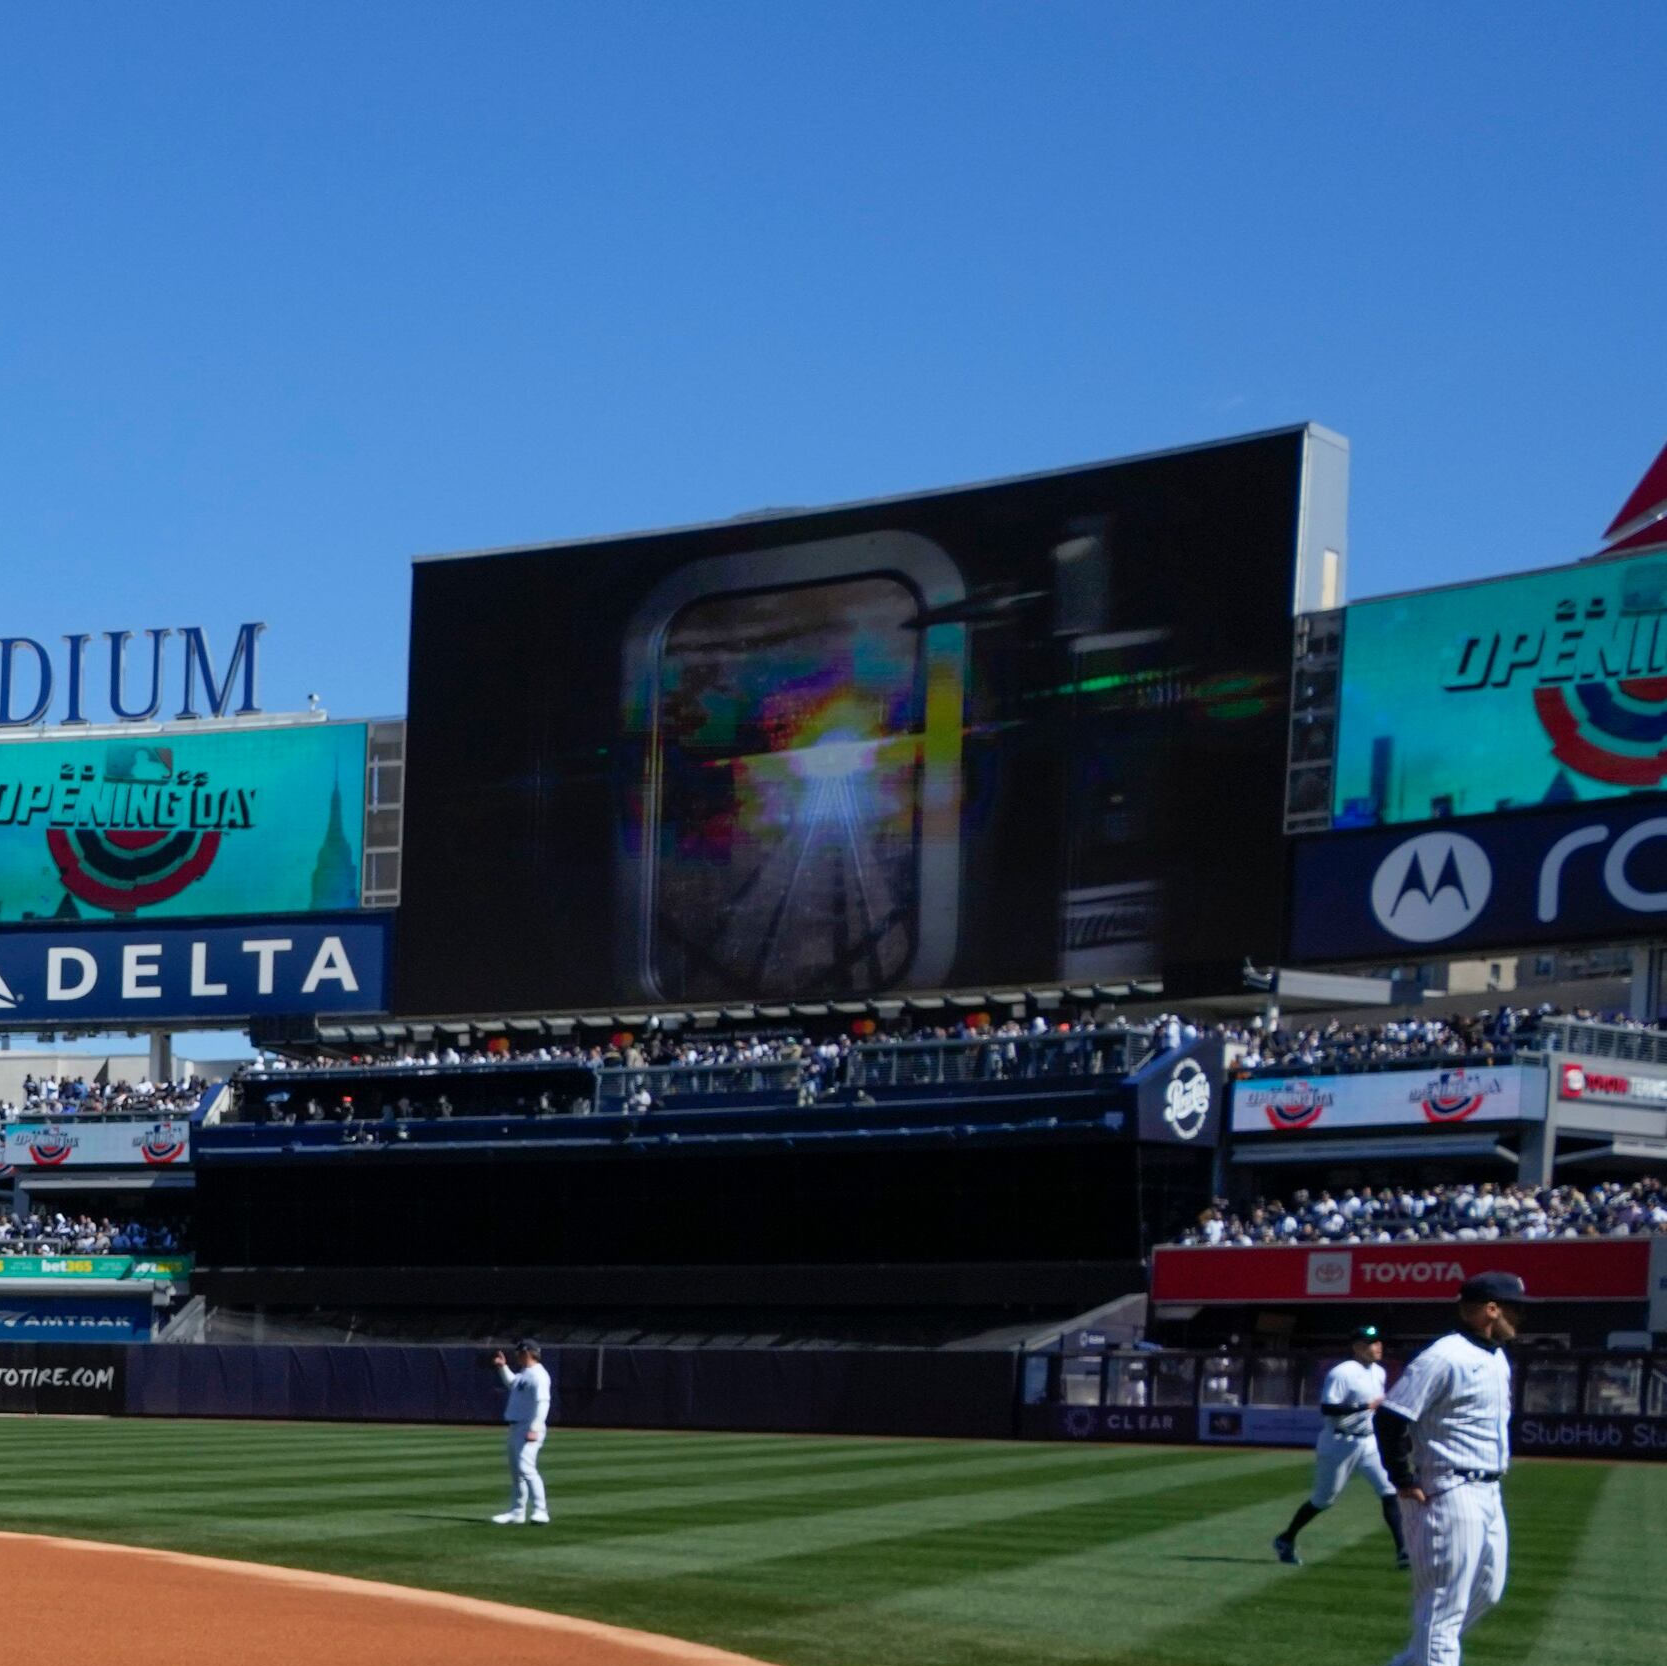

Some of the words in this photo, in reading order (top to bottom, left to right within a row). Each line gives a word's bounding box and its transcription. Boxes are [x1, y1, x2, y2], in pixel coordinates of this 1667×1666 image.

[189, 786, 259, 830] DAY
[47, 936, 360, 1001] DELTA
[42, 1258, 93, 1273] bet365
[1361, 1261, 1465, 1283] TOYOTA
[24, 1315, 131, 1328] AMTRAK
[1108, 1414, 1174, 1431] CLEAR
[1521, 1420, 1622, 1446] StubHub
